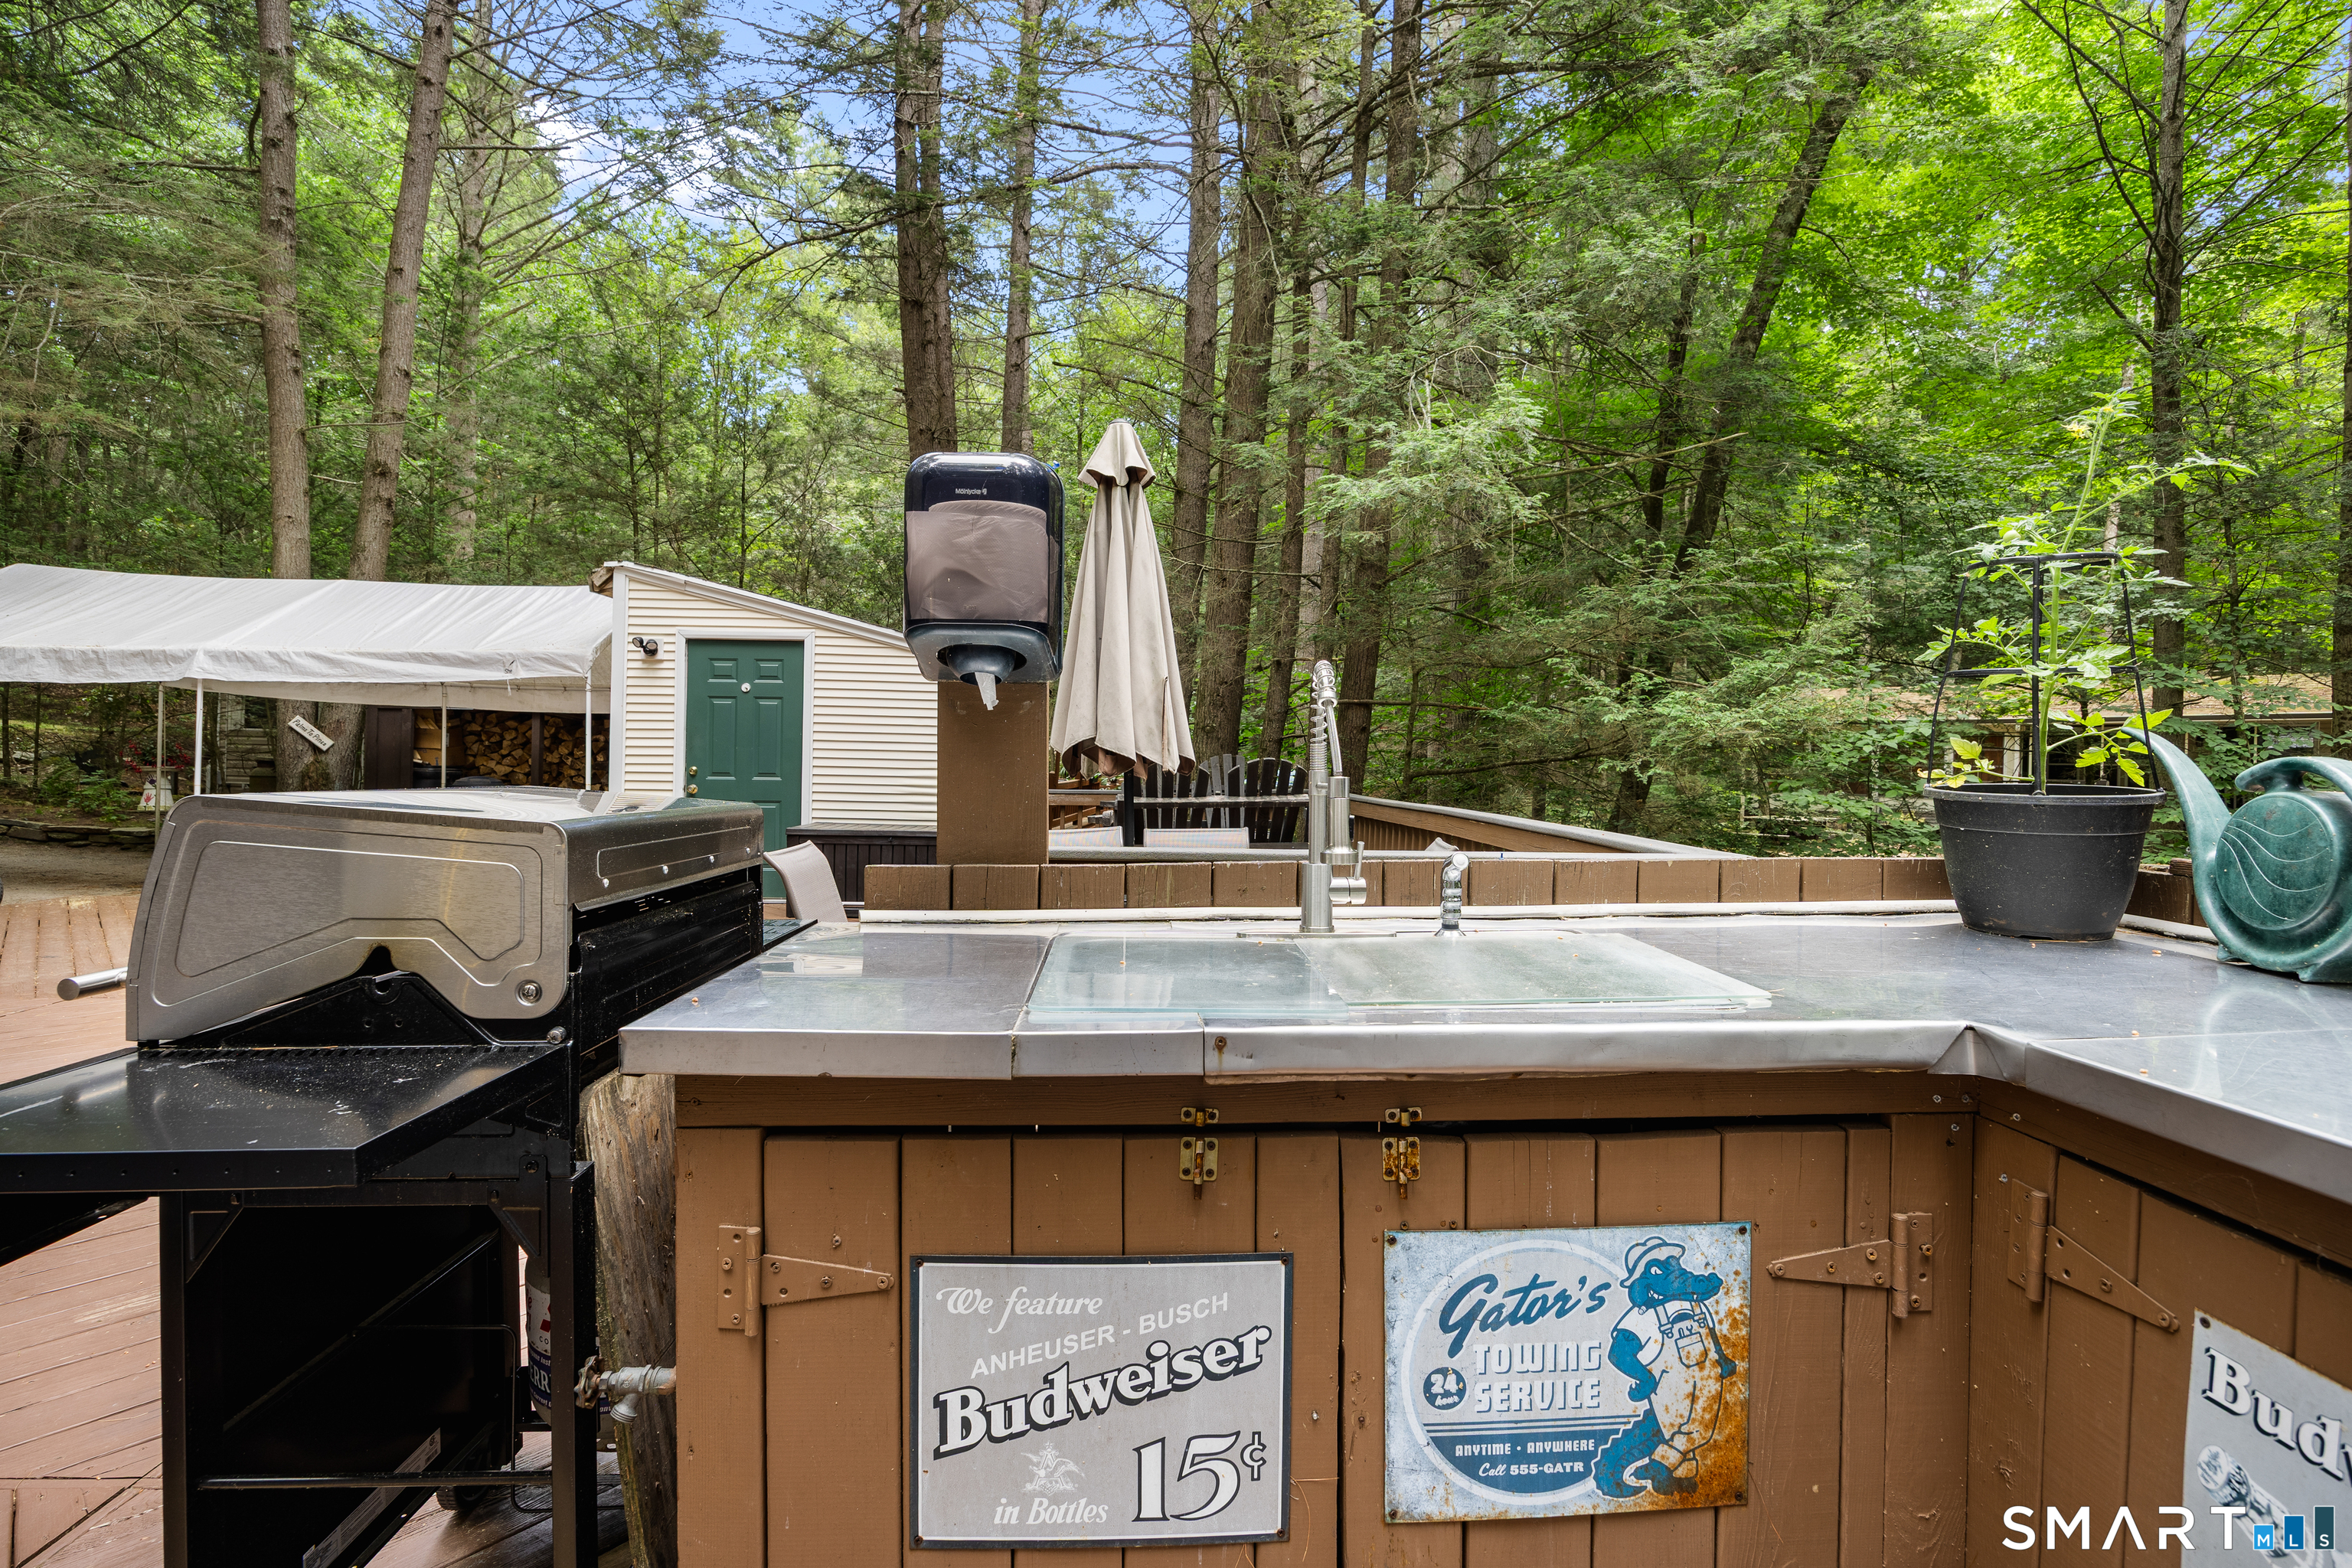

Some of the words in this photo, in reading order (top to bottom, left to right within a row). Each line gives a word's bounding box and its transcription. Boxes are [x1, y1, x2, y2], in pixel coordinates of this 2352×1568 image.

[292, 719, 307, 732] Palms
[307, 728, 315, 737] To
[312, 733, 327, 746] Pines
[936, 1286, 994, 1315] We
[988, 1286, 1103, 1334] feature
[1438, 1272, 1612, 1359] Gator's
[970, 1324, 1116, 1380] ANHEUSER
[1138, 1292, 1228, 1335] BUSCH
[1472, 1340, 1602, 1376] TOWING
[933, 1325, 1272, 1460] Budweiser
[1430, 1374, 1459, 1394] 24
[1473, 1378, 1601, 1413] SERVICE
[1455, 1442, 1511, 1457] ANYTIME
[1527, 1439, 1595, 1454] ANYWHERE
[1478, 1462, 1507, 1478] Call
[1509, 1461, 1585, 1476] 555-GATR
[994, 1497, 1018, 1524] in
[1026, 1497, 1109, 1525] Bottles
